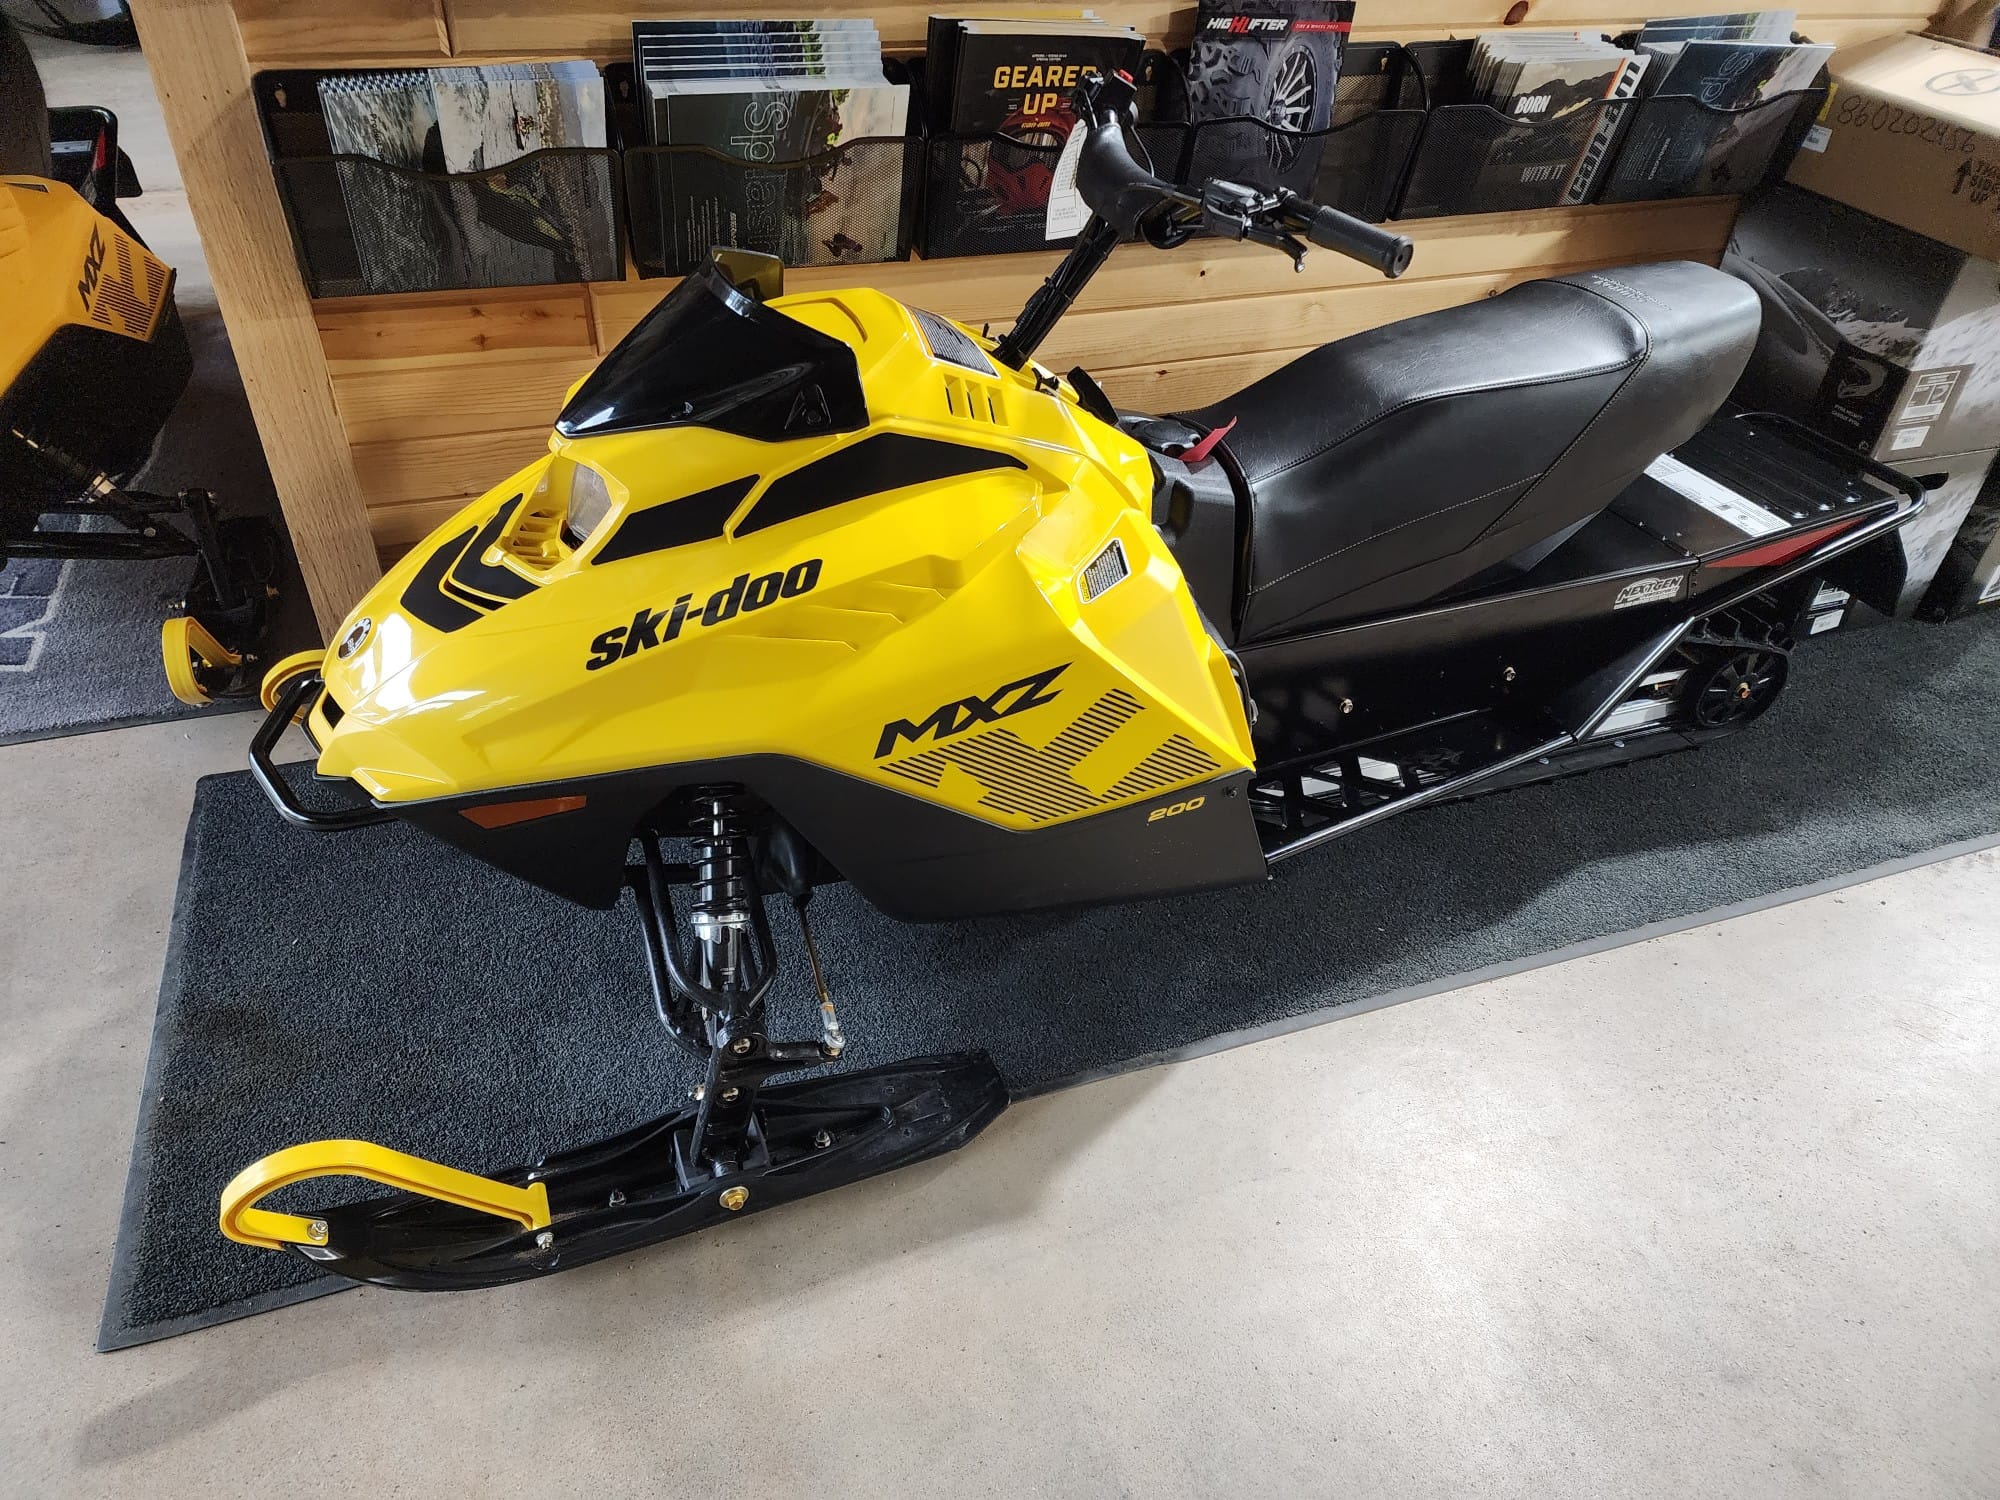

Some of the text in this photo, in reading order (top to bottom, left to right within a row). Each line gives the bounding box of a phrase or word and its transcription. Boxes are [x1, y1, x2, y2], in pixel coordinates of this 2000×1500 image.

[1023, 93, 1058, 115] UP
[1513, 94, 1551, 115] BORN
[1520, 163, 1567, 183] WITH IT
[78, 220, 106, 313] MXZ
[586, 558, 823, 671] ski-doo
[873, 661, 1073, 760] MXZ
[1147, 796, 1205, 823] 200
